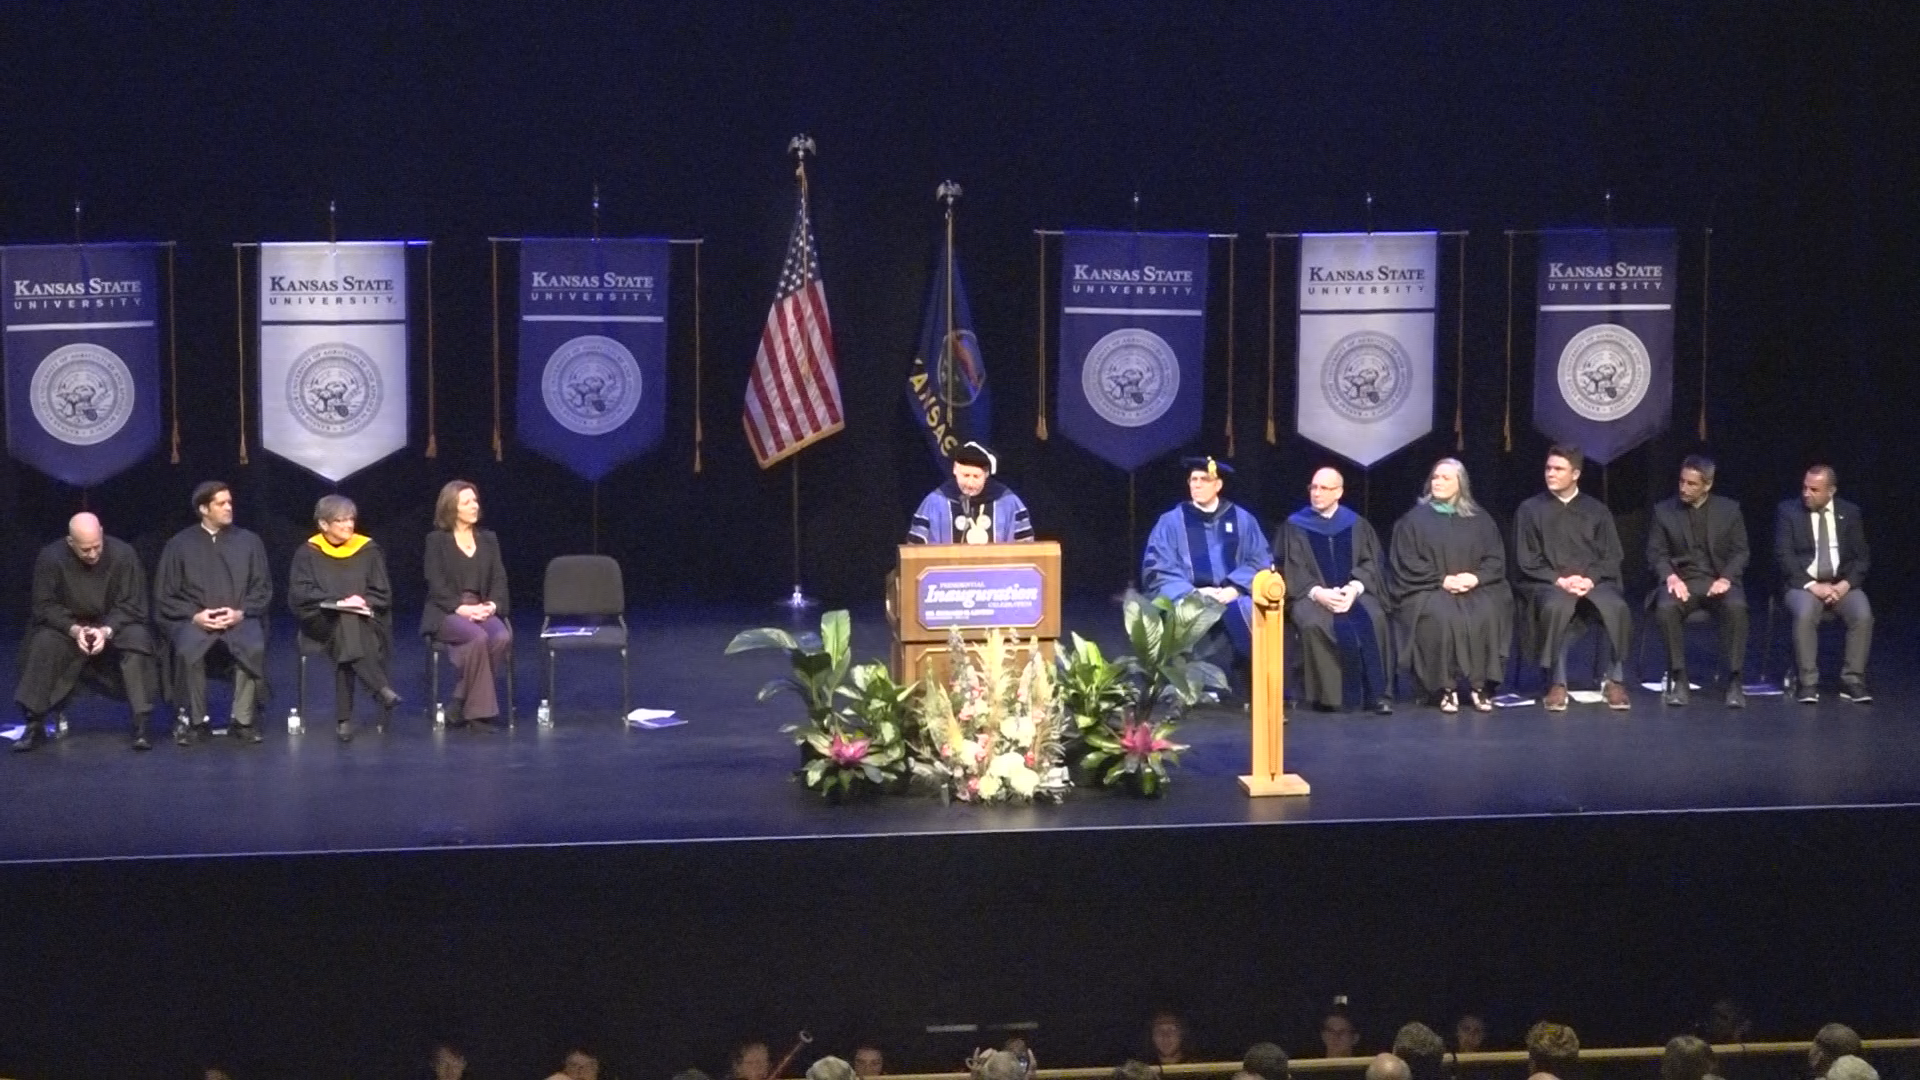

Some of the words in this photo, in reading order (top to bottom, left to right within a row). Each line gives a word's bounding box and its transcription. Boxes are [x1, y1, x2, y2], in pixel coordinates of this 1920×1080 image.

[1073, 264, 1140, 281] KANSAS
[1143, 265, 1193, 282] STATE
[1309, 266, 1374, 282] KANSAS
[1377, 265, 1425, 281] STATE
[1549, 262, 1613, 278] KANSAS
[1615, 261, 1663, 278] STATE
[14, 279, 85, 296] KANSAS
[89, 277, 142, 294] STATE
[269, 276, 339, 292] KANSAS
[342, 275, 394, 291] STATE
[531, 271, 600, 288] KANSAS
[603, 271, 654, 288] STATE
[1548, 282, 1662, 291] UNIVERSITY
[531, 292, 653, 301] UNIVERSITY
[1072, 285, 1192, 296] UNIVERSITY
[1308, 285, 1424, 295] UNIVERSITY
[14, 297, 141, 310] UNIVERSITY
[269, 296, 393, 305] UNIVERSITY
[924, 583, 1038, 608] Inauguration
